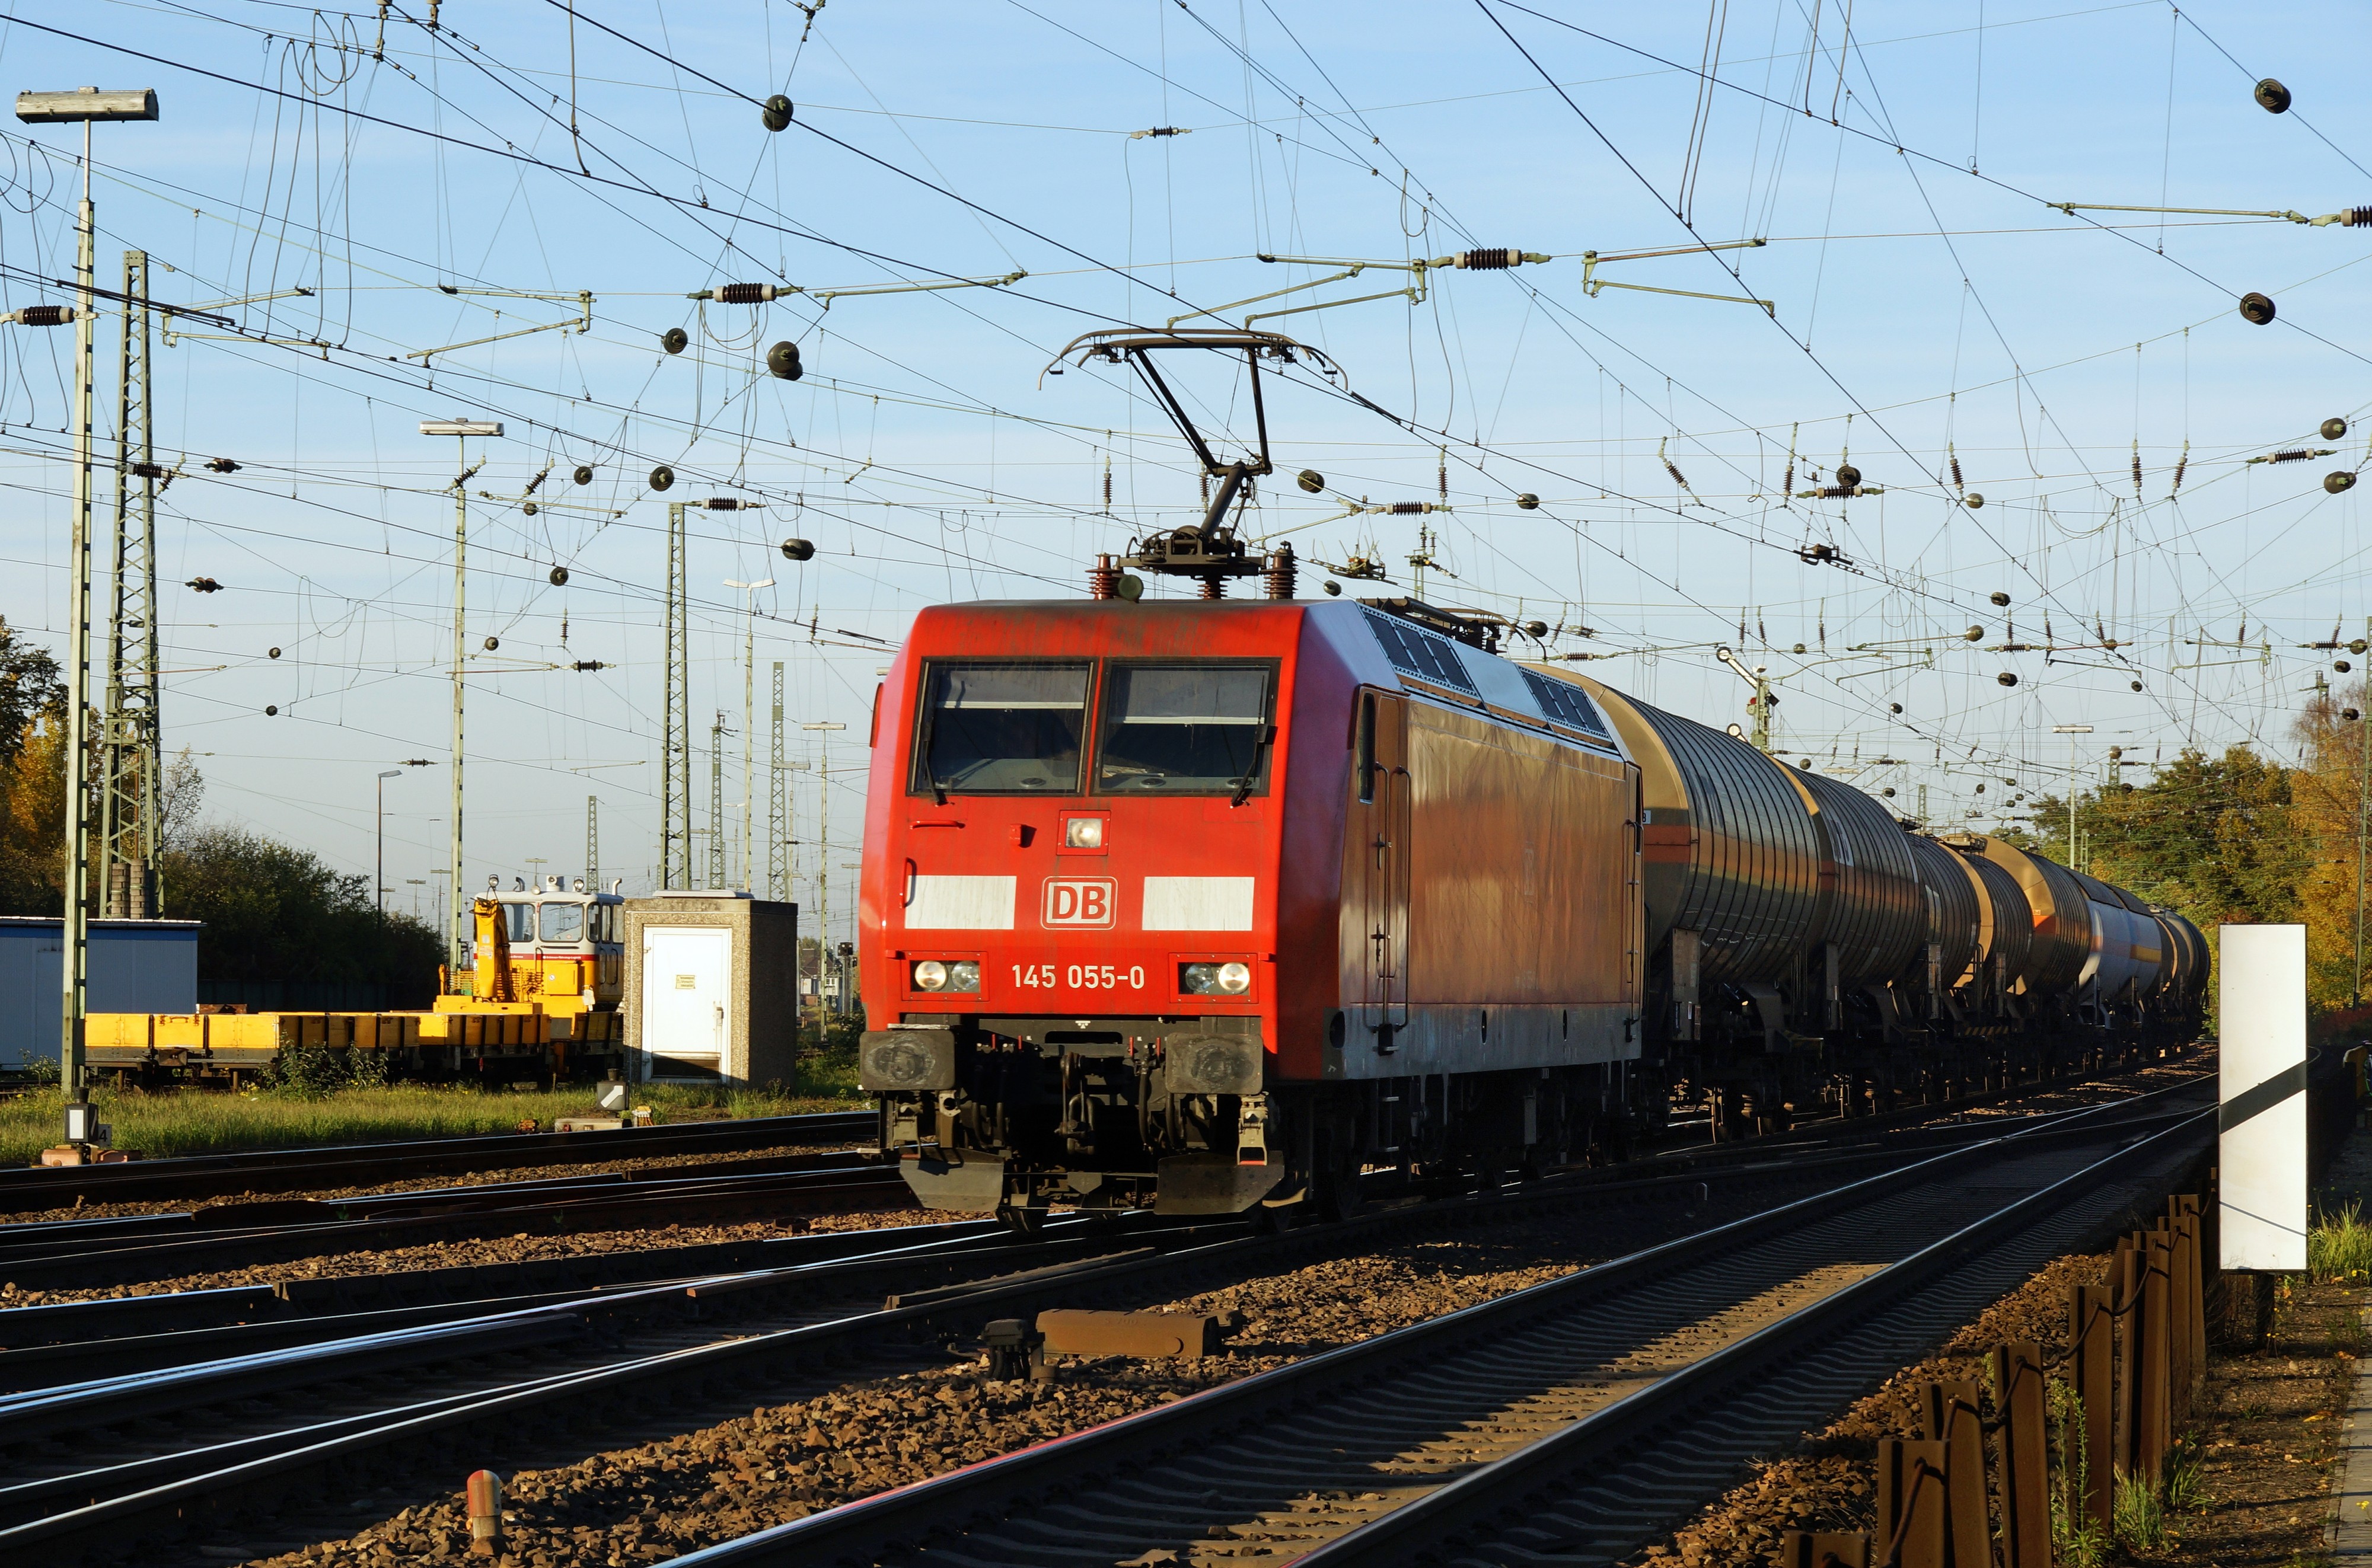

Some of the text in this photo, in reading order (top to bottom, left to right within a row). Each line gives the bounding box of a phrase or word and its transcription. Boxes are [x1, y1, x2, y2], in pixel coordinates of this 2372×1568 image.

[1051, 886, 1107, 919] DB
[1012, 965, 1144, 989] 145 055-0
